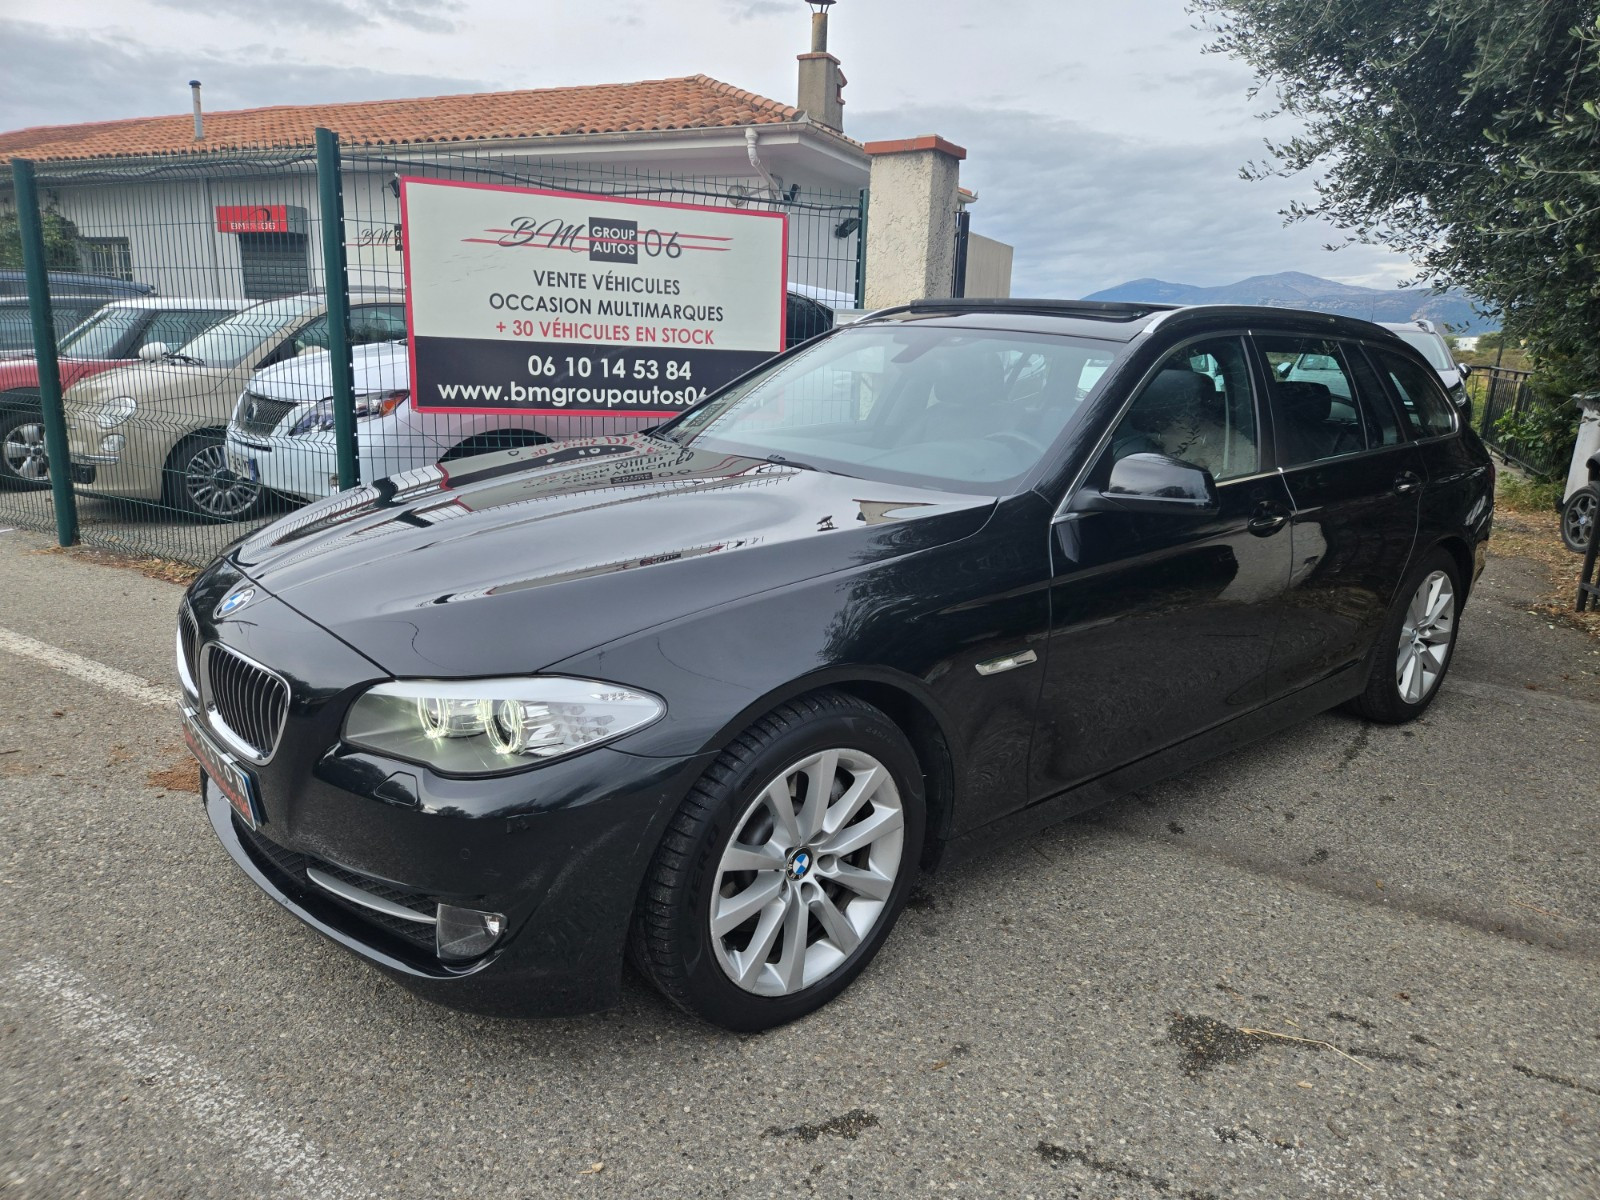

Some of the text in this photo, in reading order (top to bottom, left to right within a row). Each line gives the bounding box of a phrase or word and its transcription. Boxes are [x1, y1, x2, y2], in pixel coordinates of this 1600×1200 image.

[497, 216, 586, 253] BM
[592, 226, 635, 240] GROUP
[645, 229, 682, 258] 06
[592, 241, 635, 255] AUTOS
[533, 269, 681, 295] VENTE VÉHICULES
[489, 292, 724, 321] OCCASION MULTIMARQUES
[513, 319, 534, 337] 30
[539, 317, 630, 341] VÉHICULES
[636, 326, 656, 342] EN
[662, 327, 715, 345] STOCK
[527, 355, 692, 380] 06 10 14 53 84
